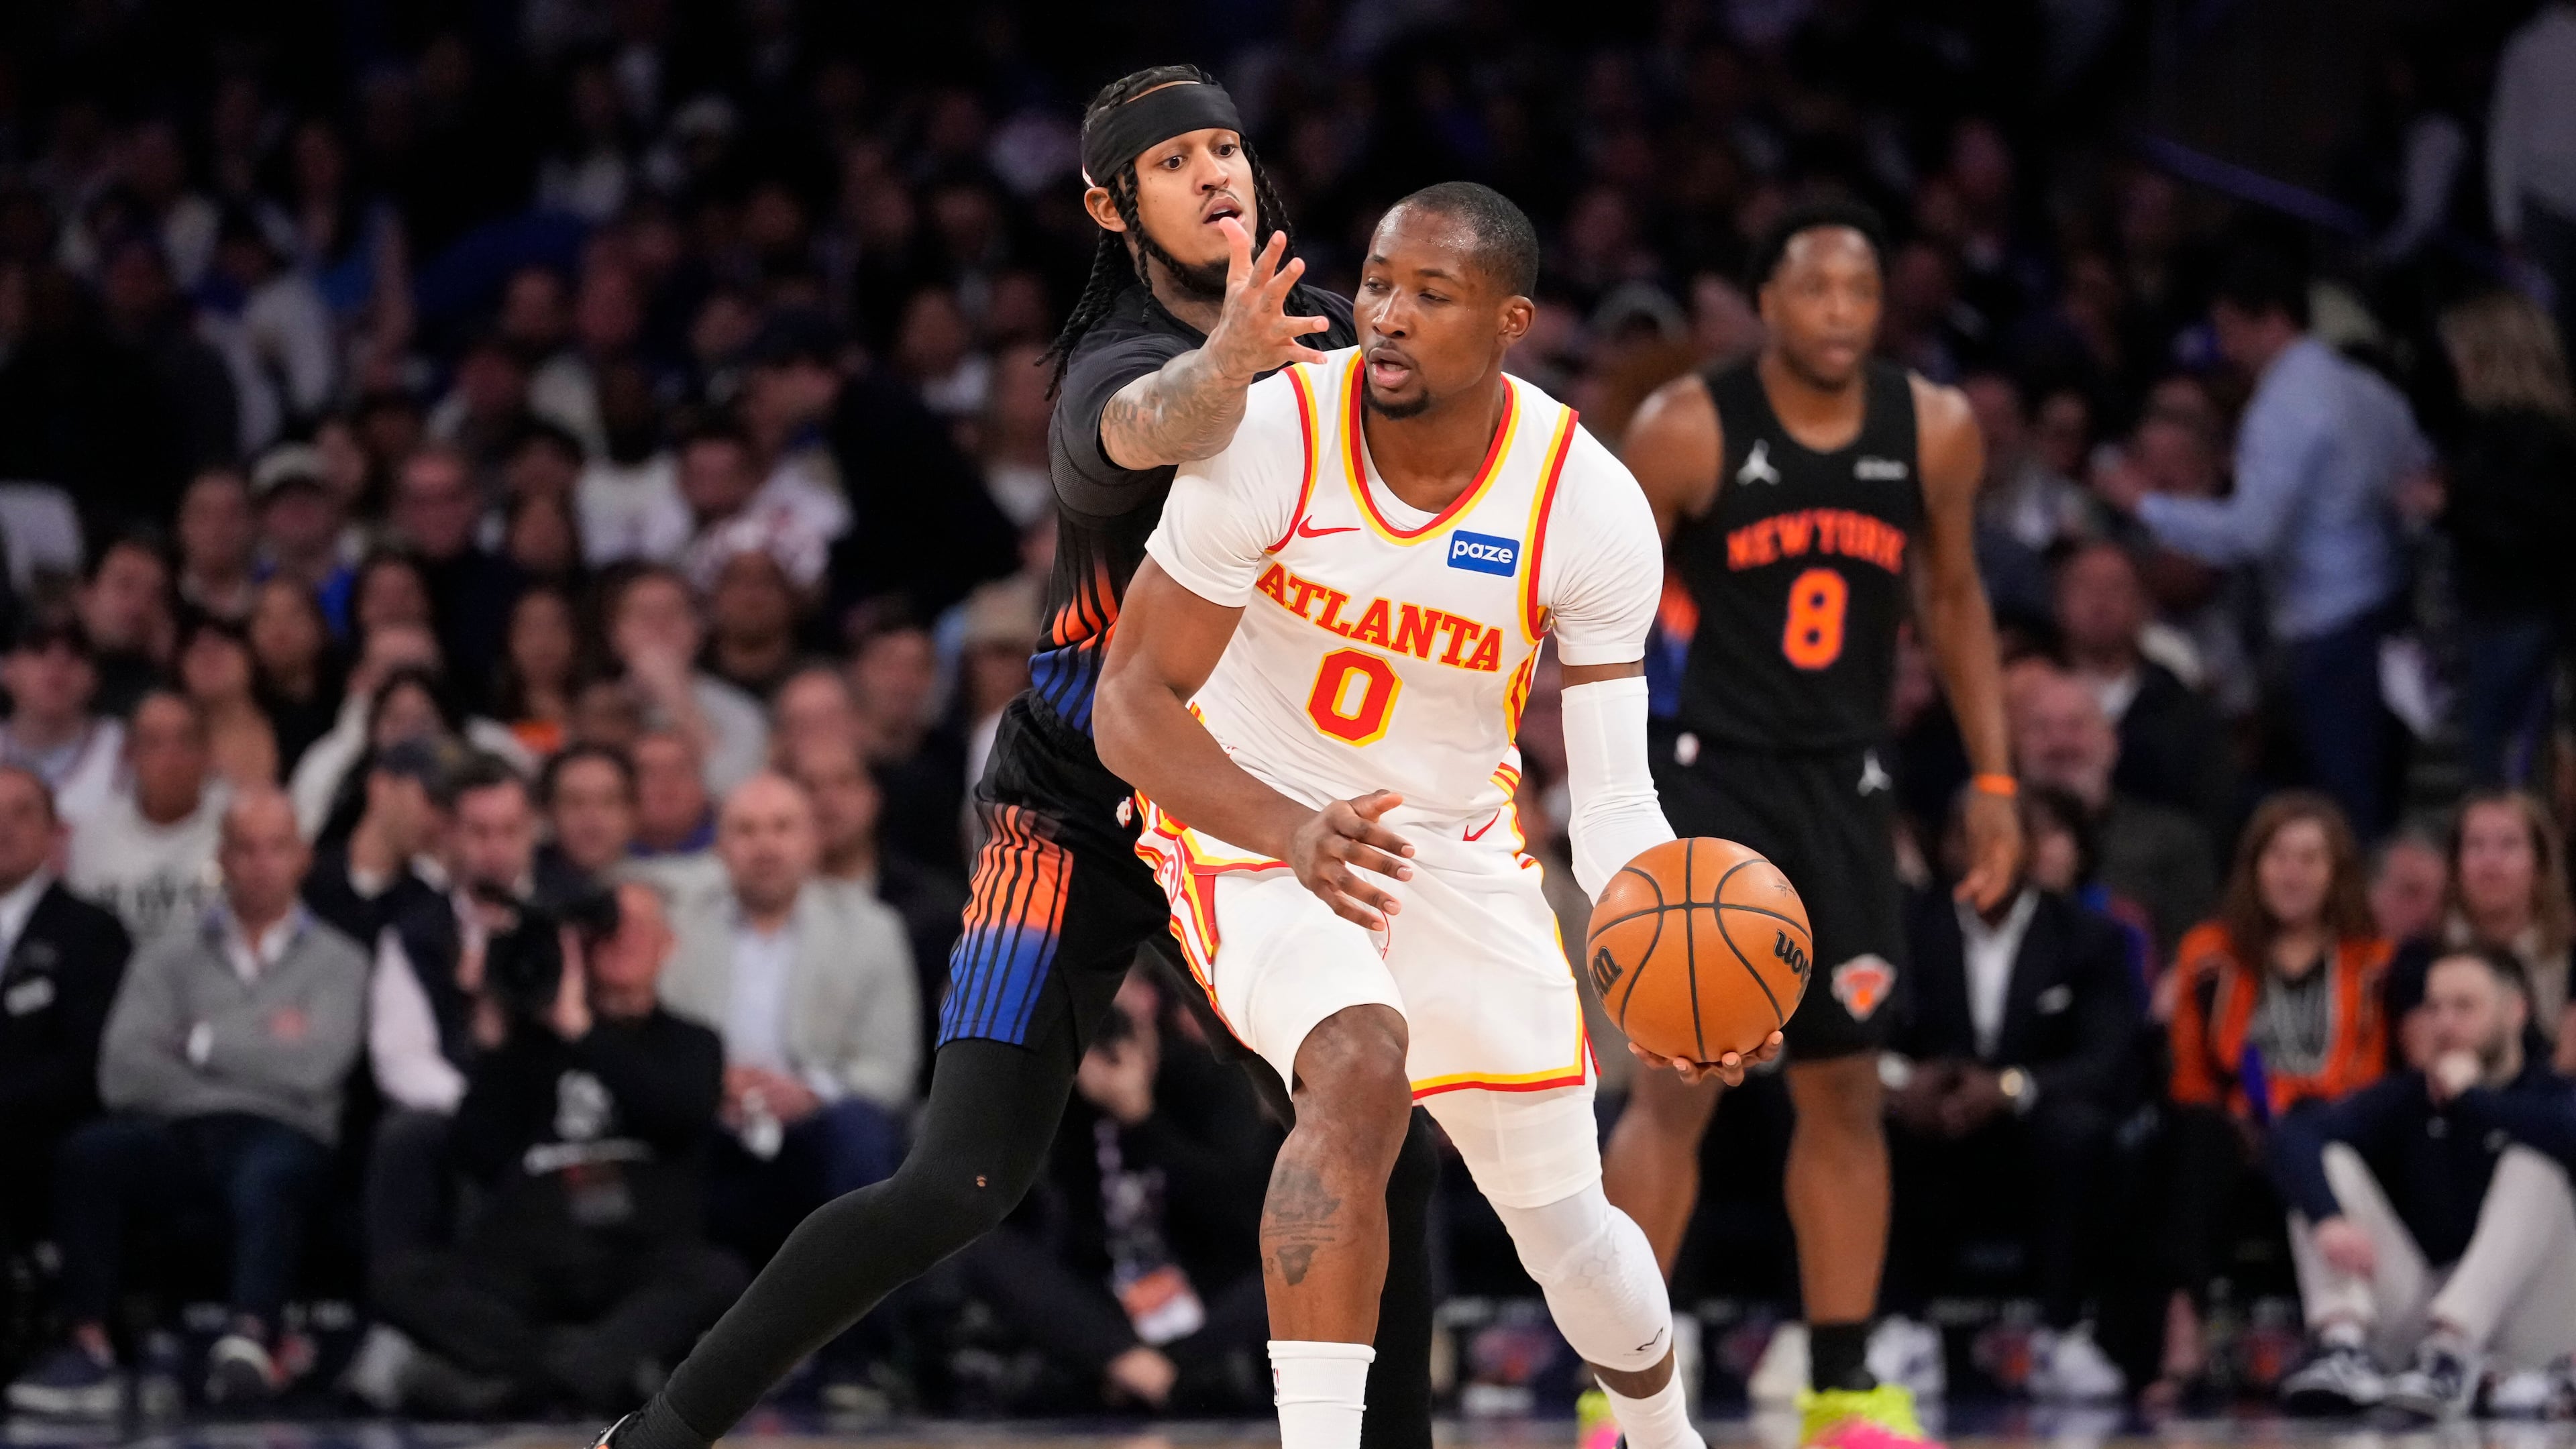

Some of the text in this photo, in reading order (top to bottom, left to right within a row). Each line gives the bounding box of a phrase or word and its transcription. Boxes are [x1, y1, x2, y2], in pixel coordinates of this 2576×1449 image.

[1452, 539, 1513, 564] paze
[1726, 507, 1906, 575] NEW YORK
[1255, 561, 1503, 674] ATLANTA
[1782, 568, 1848, 670] 8
[1305, 646, 1404, 748] 0
